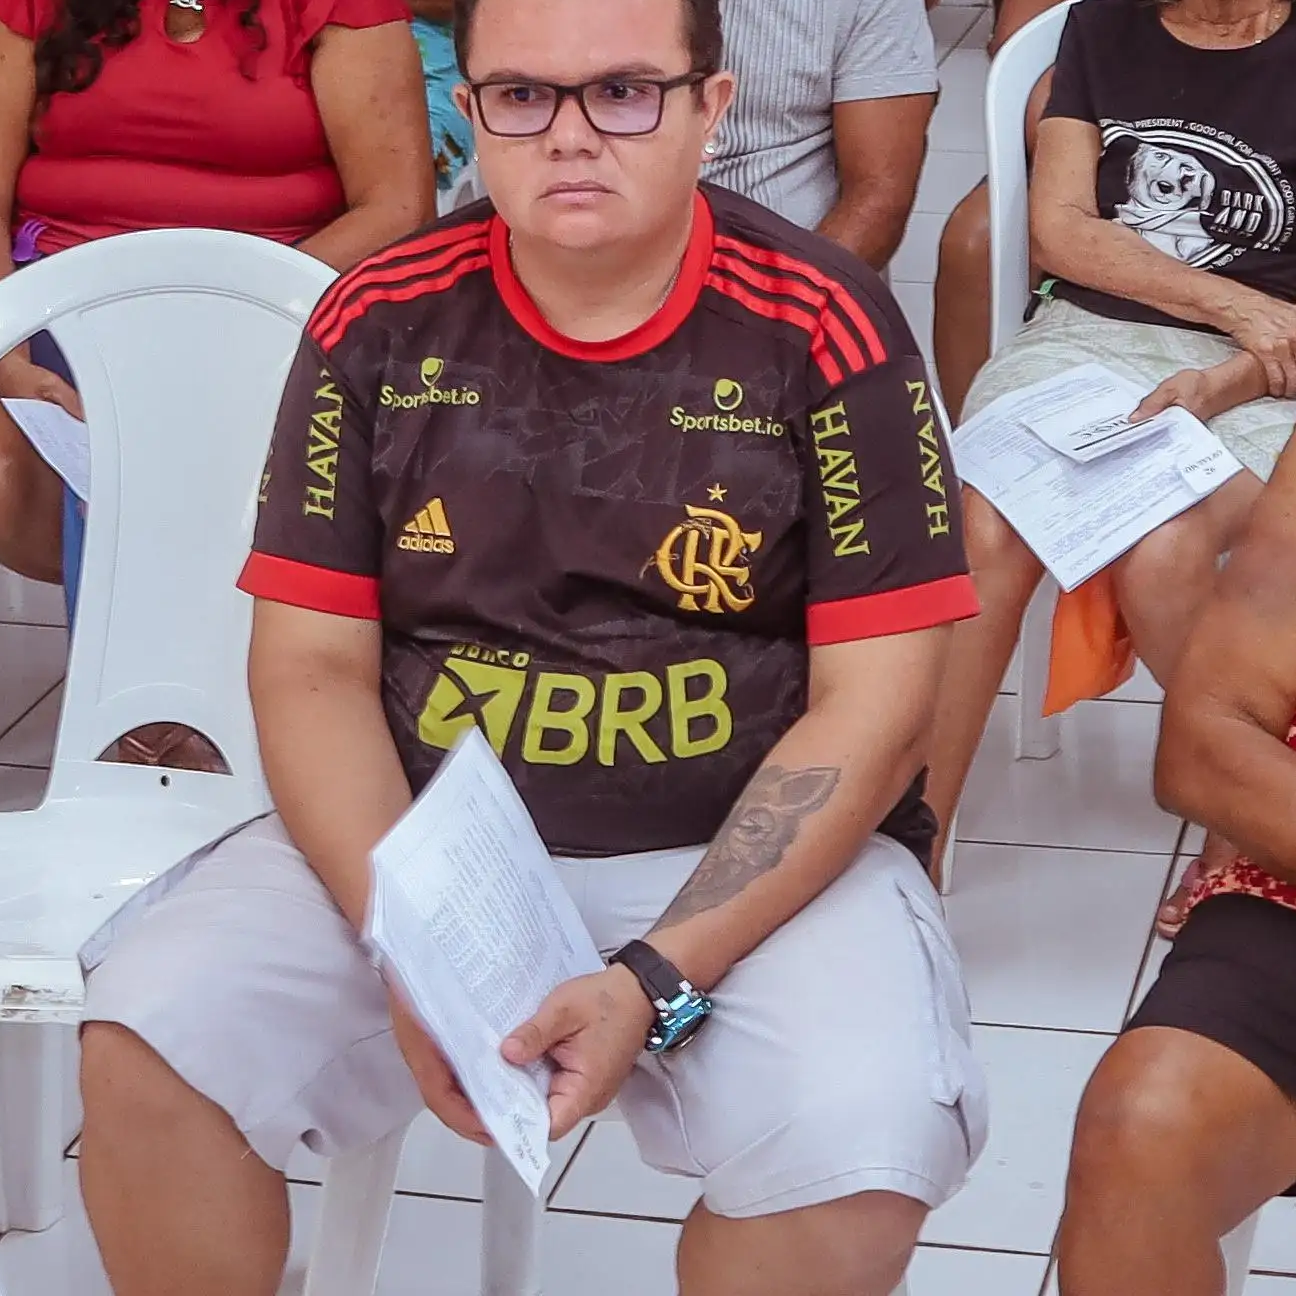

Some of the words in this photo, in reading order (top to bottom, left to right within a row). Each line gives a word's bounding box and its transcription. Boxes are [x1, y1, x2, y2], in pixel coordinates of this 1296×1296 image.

[1135, 118, 1185, 129] PRESIDENT
[1189, 122, 1218, 137] GOOD
[1217, 130, 1236, 146] GIRL
[1221, 189, 1265, 213] BARK
[1279, 179, 1296, 205] GOOD
[1213, 206, 1262, 233] AND
[669, 406, 784, 436] Sportsbet.io
[904, 379, 951, 540] HAVAN
[810, 400, 872, 557] HAVAN
[397, 534, 455, 554] adidas
[521, 658, 733, 767] BRB
